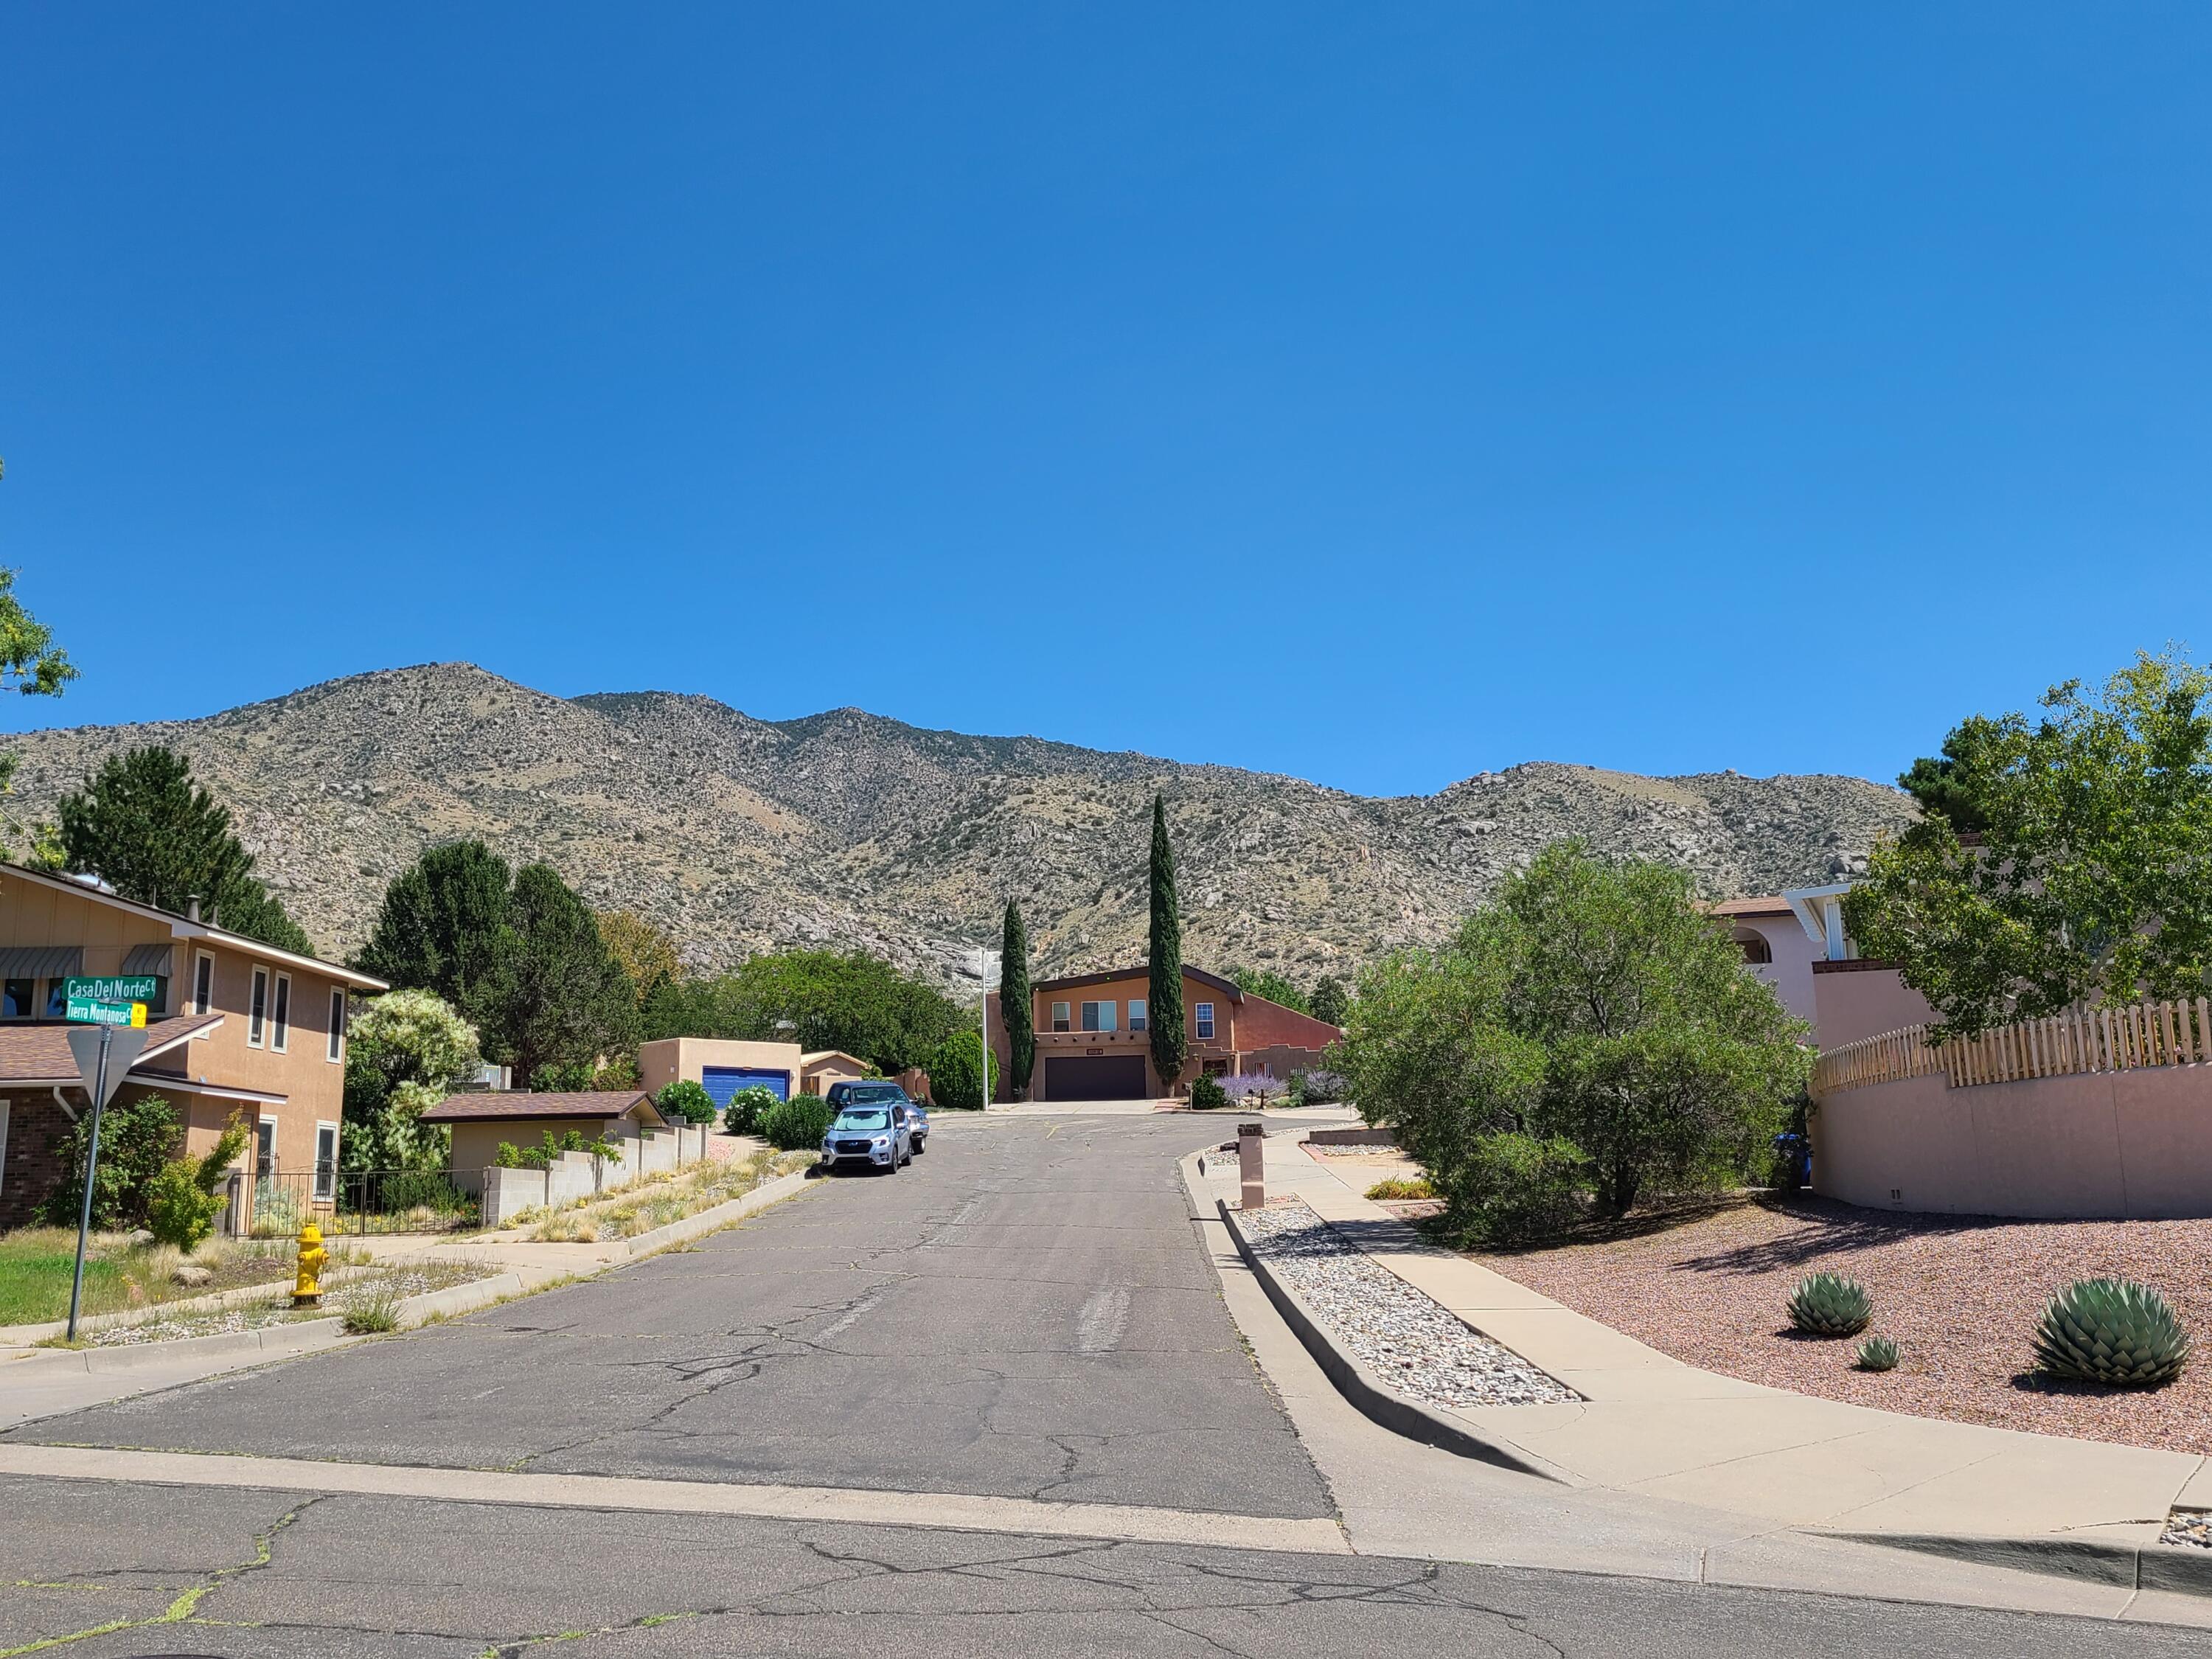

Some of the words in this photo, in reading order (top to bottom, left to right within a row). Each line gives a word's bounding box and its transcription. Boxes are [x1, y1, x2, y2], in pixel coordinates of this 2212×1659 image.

[145, 979, 156, 992] Ct
[67, 1001, 88, 1020] Tierra
[89, 1003, 126, 1023] Montanosa
